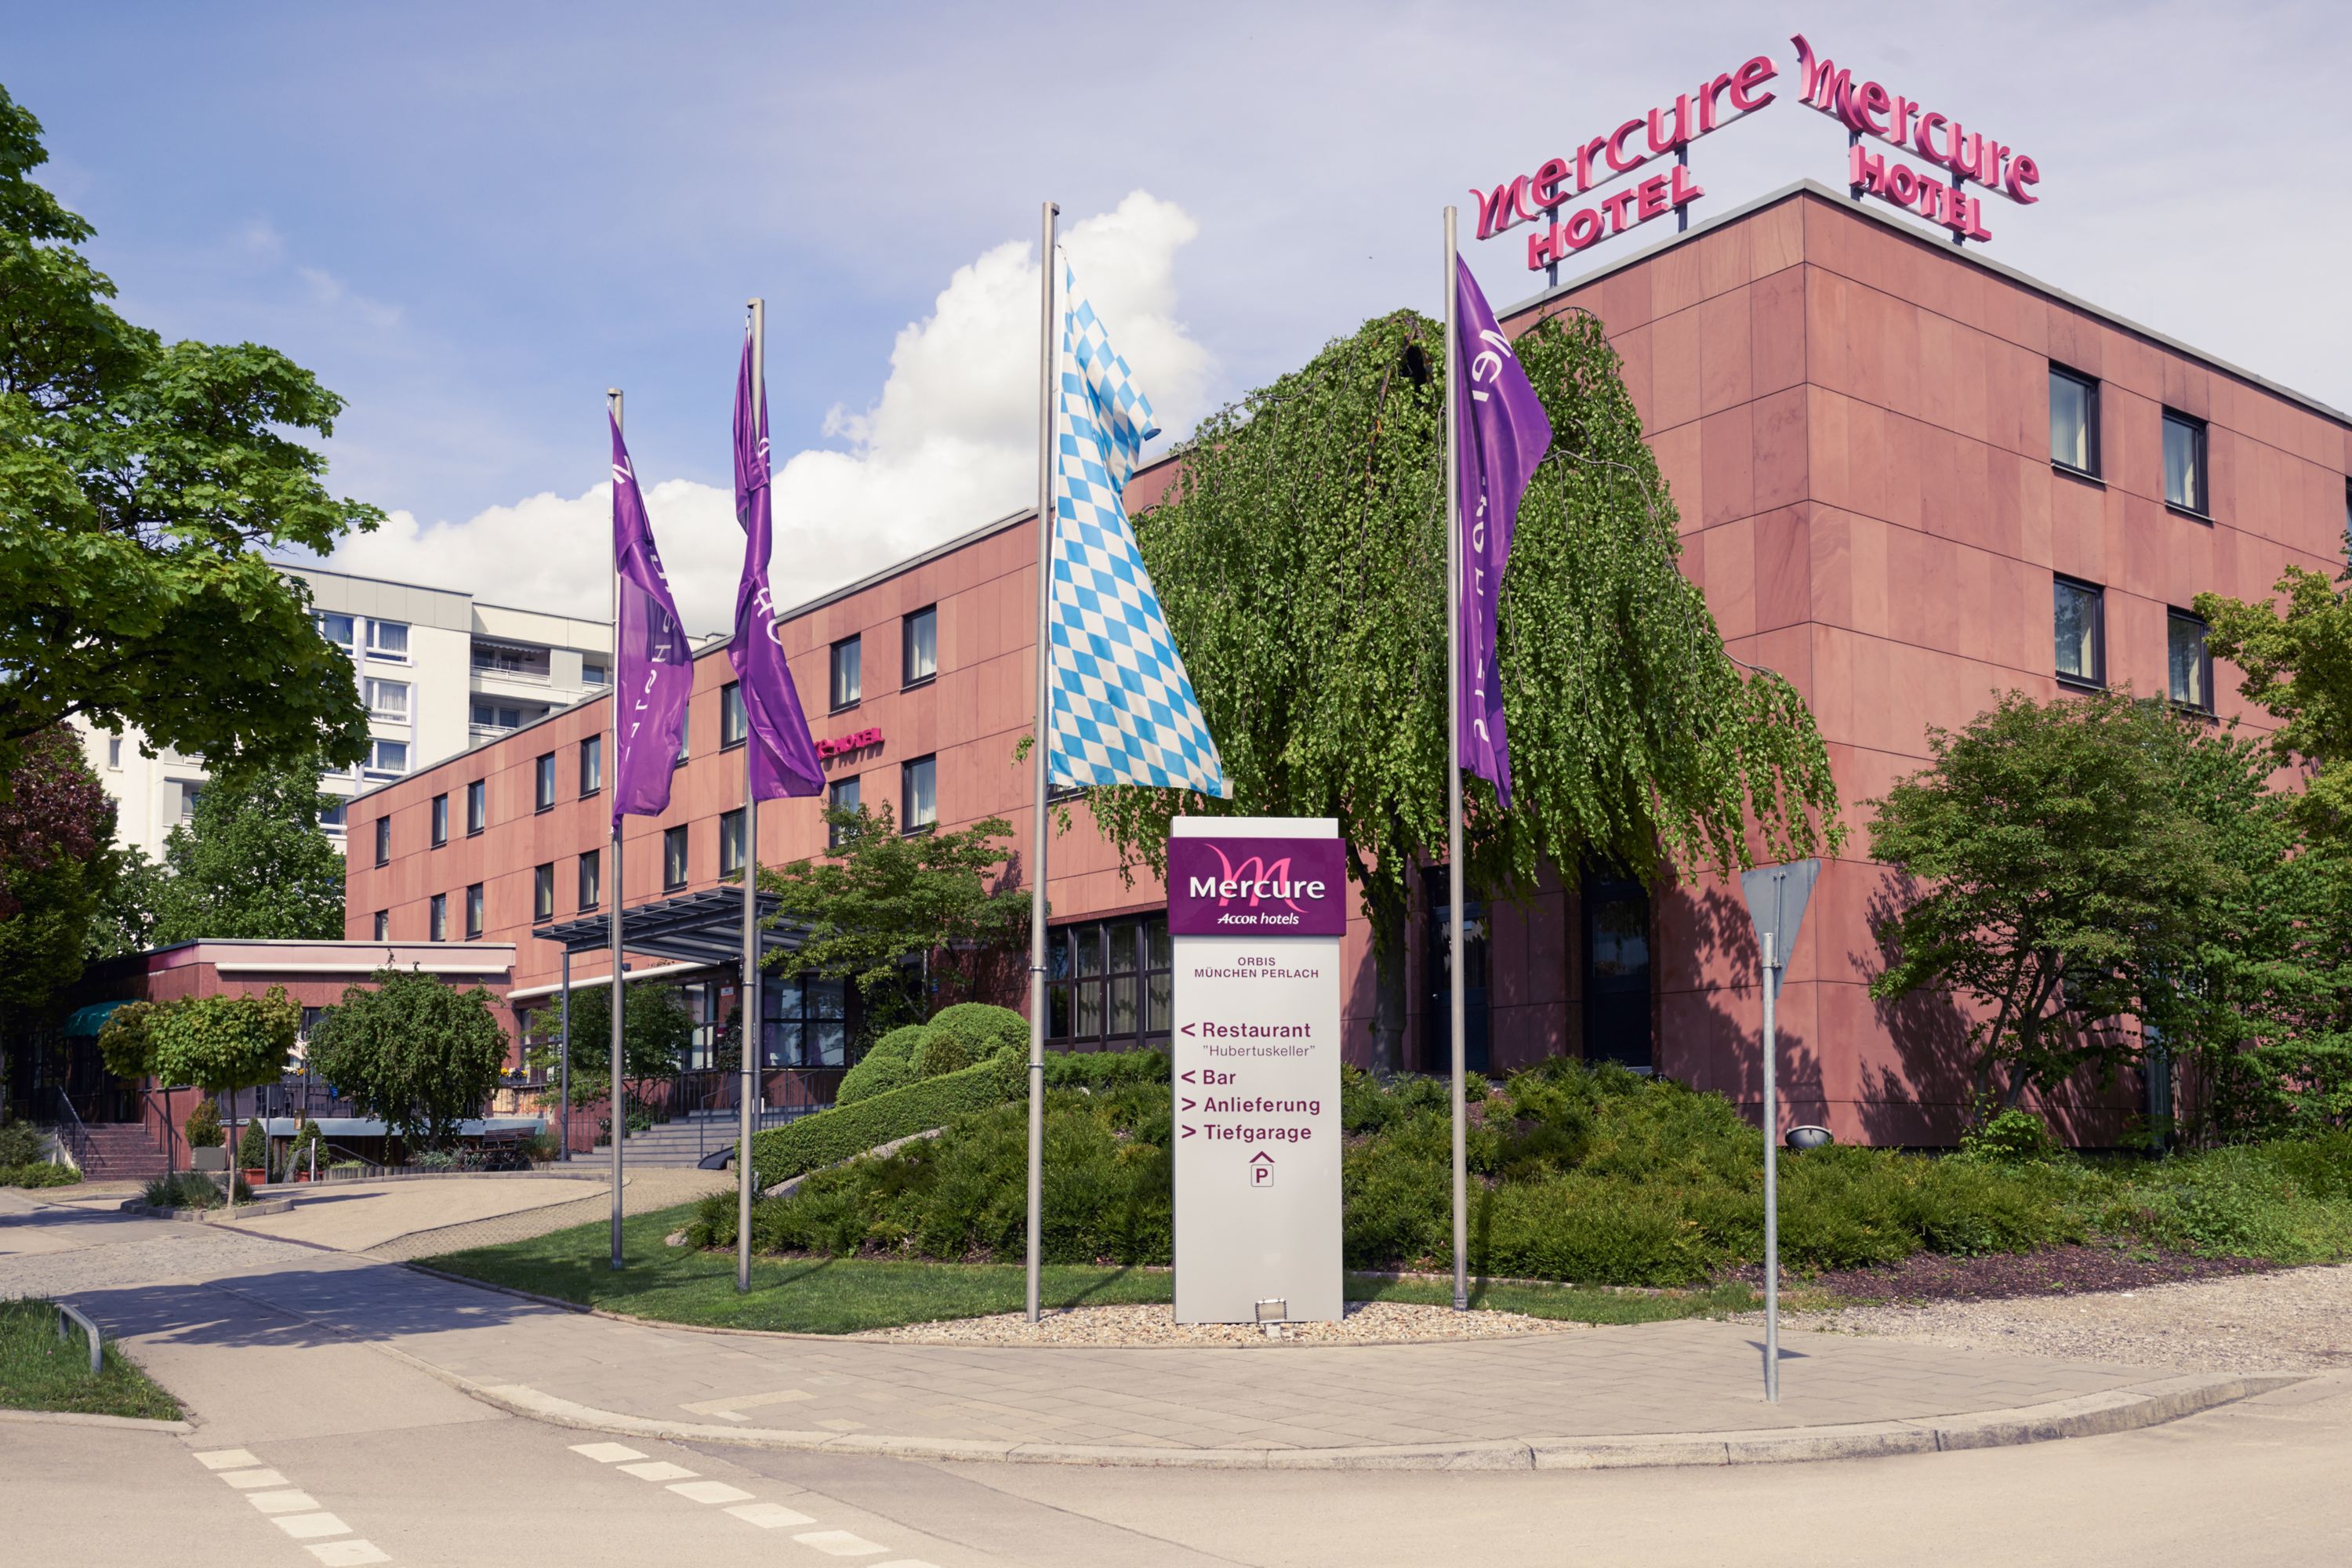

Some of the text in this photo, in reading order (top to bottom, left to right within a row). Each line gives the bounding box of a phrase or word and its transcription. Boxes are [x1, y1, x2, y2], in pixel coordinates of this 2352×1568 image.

[1849, 144, 1992, 243] HOTEL
[1528, 164, 1704, 271] HOTEL
[1189, 877, 1325, 899] Mercure
[1260, 913, 1299, 925] hotels
[1237, 956, 1276, 967] ORBIS
[1194, 966, 1319, 978] MÜNCHEN PERLACH
[1203, 1022, 1311, 1038] Restaurant
[1203, 1069, 1236, 1085] Bar
[1203, 1096, 1320, 1116] Anlieferung
[1203, 1123, 1312, 1143] Tiefgarage
[1255, 1168, 1269, 1184] P
